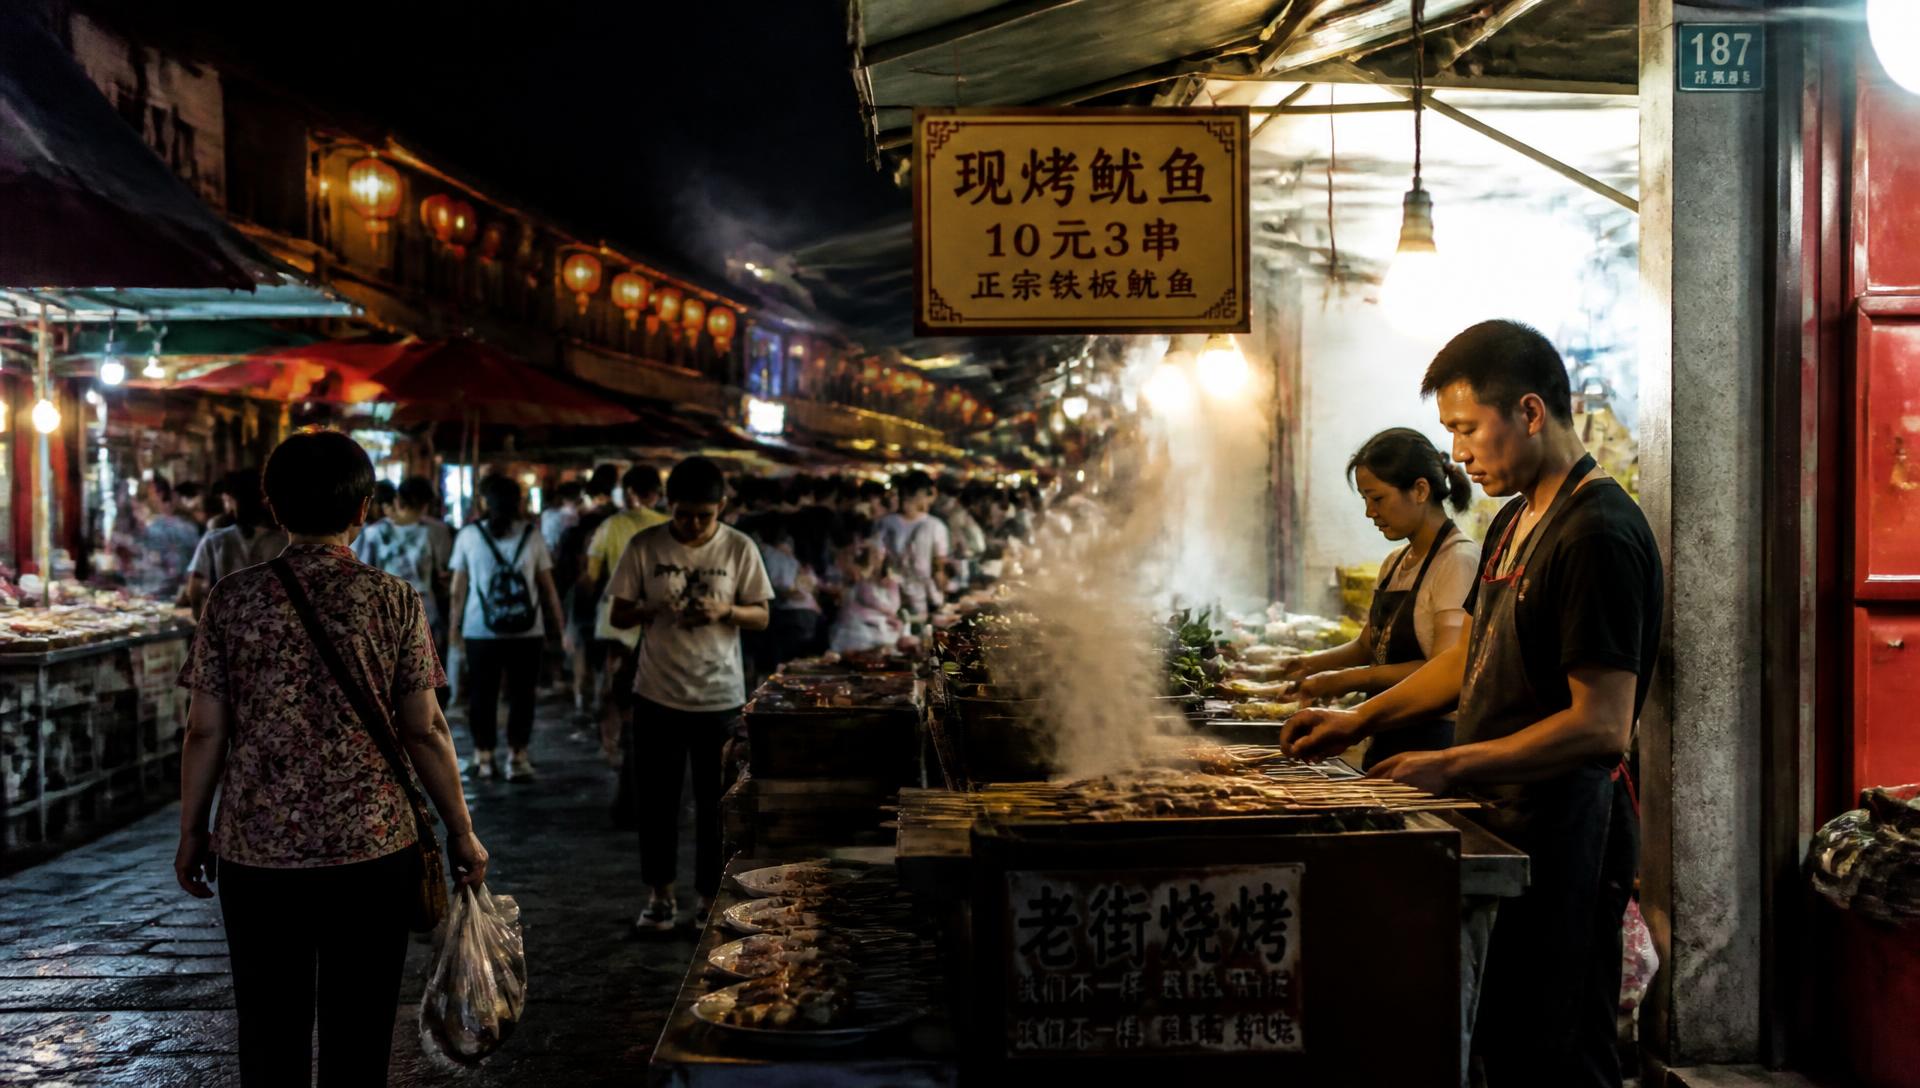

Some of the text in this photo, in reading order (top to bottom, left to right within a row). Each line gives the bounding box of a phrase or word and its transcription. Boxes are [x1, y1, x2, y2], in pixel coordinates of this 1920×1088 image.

[1691, 32, 1752, 66] 187
[953, 147, 1212, 206] 现烤鱿鱼
[985, 218, 1180, 262] 10元3串
[970, 269, 1197, 300] 正宗铁板鱿鱼
[1017, 883, 1292, 965] 老街烧烤
